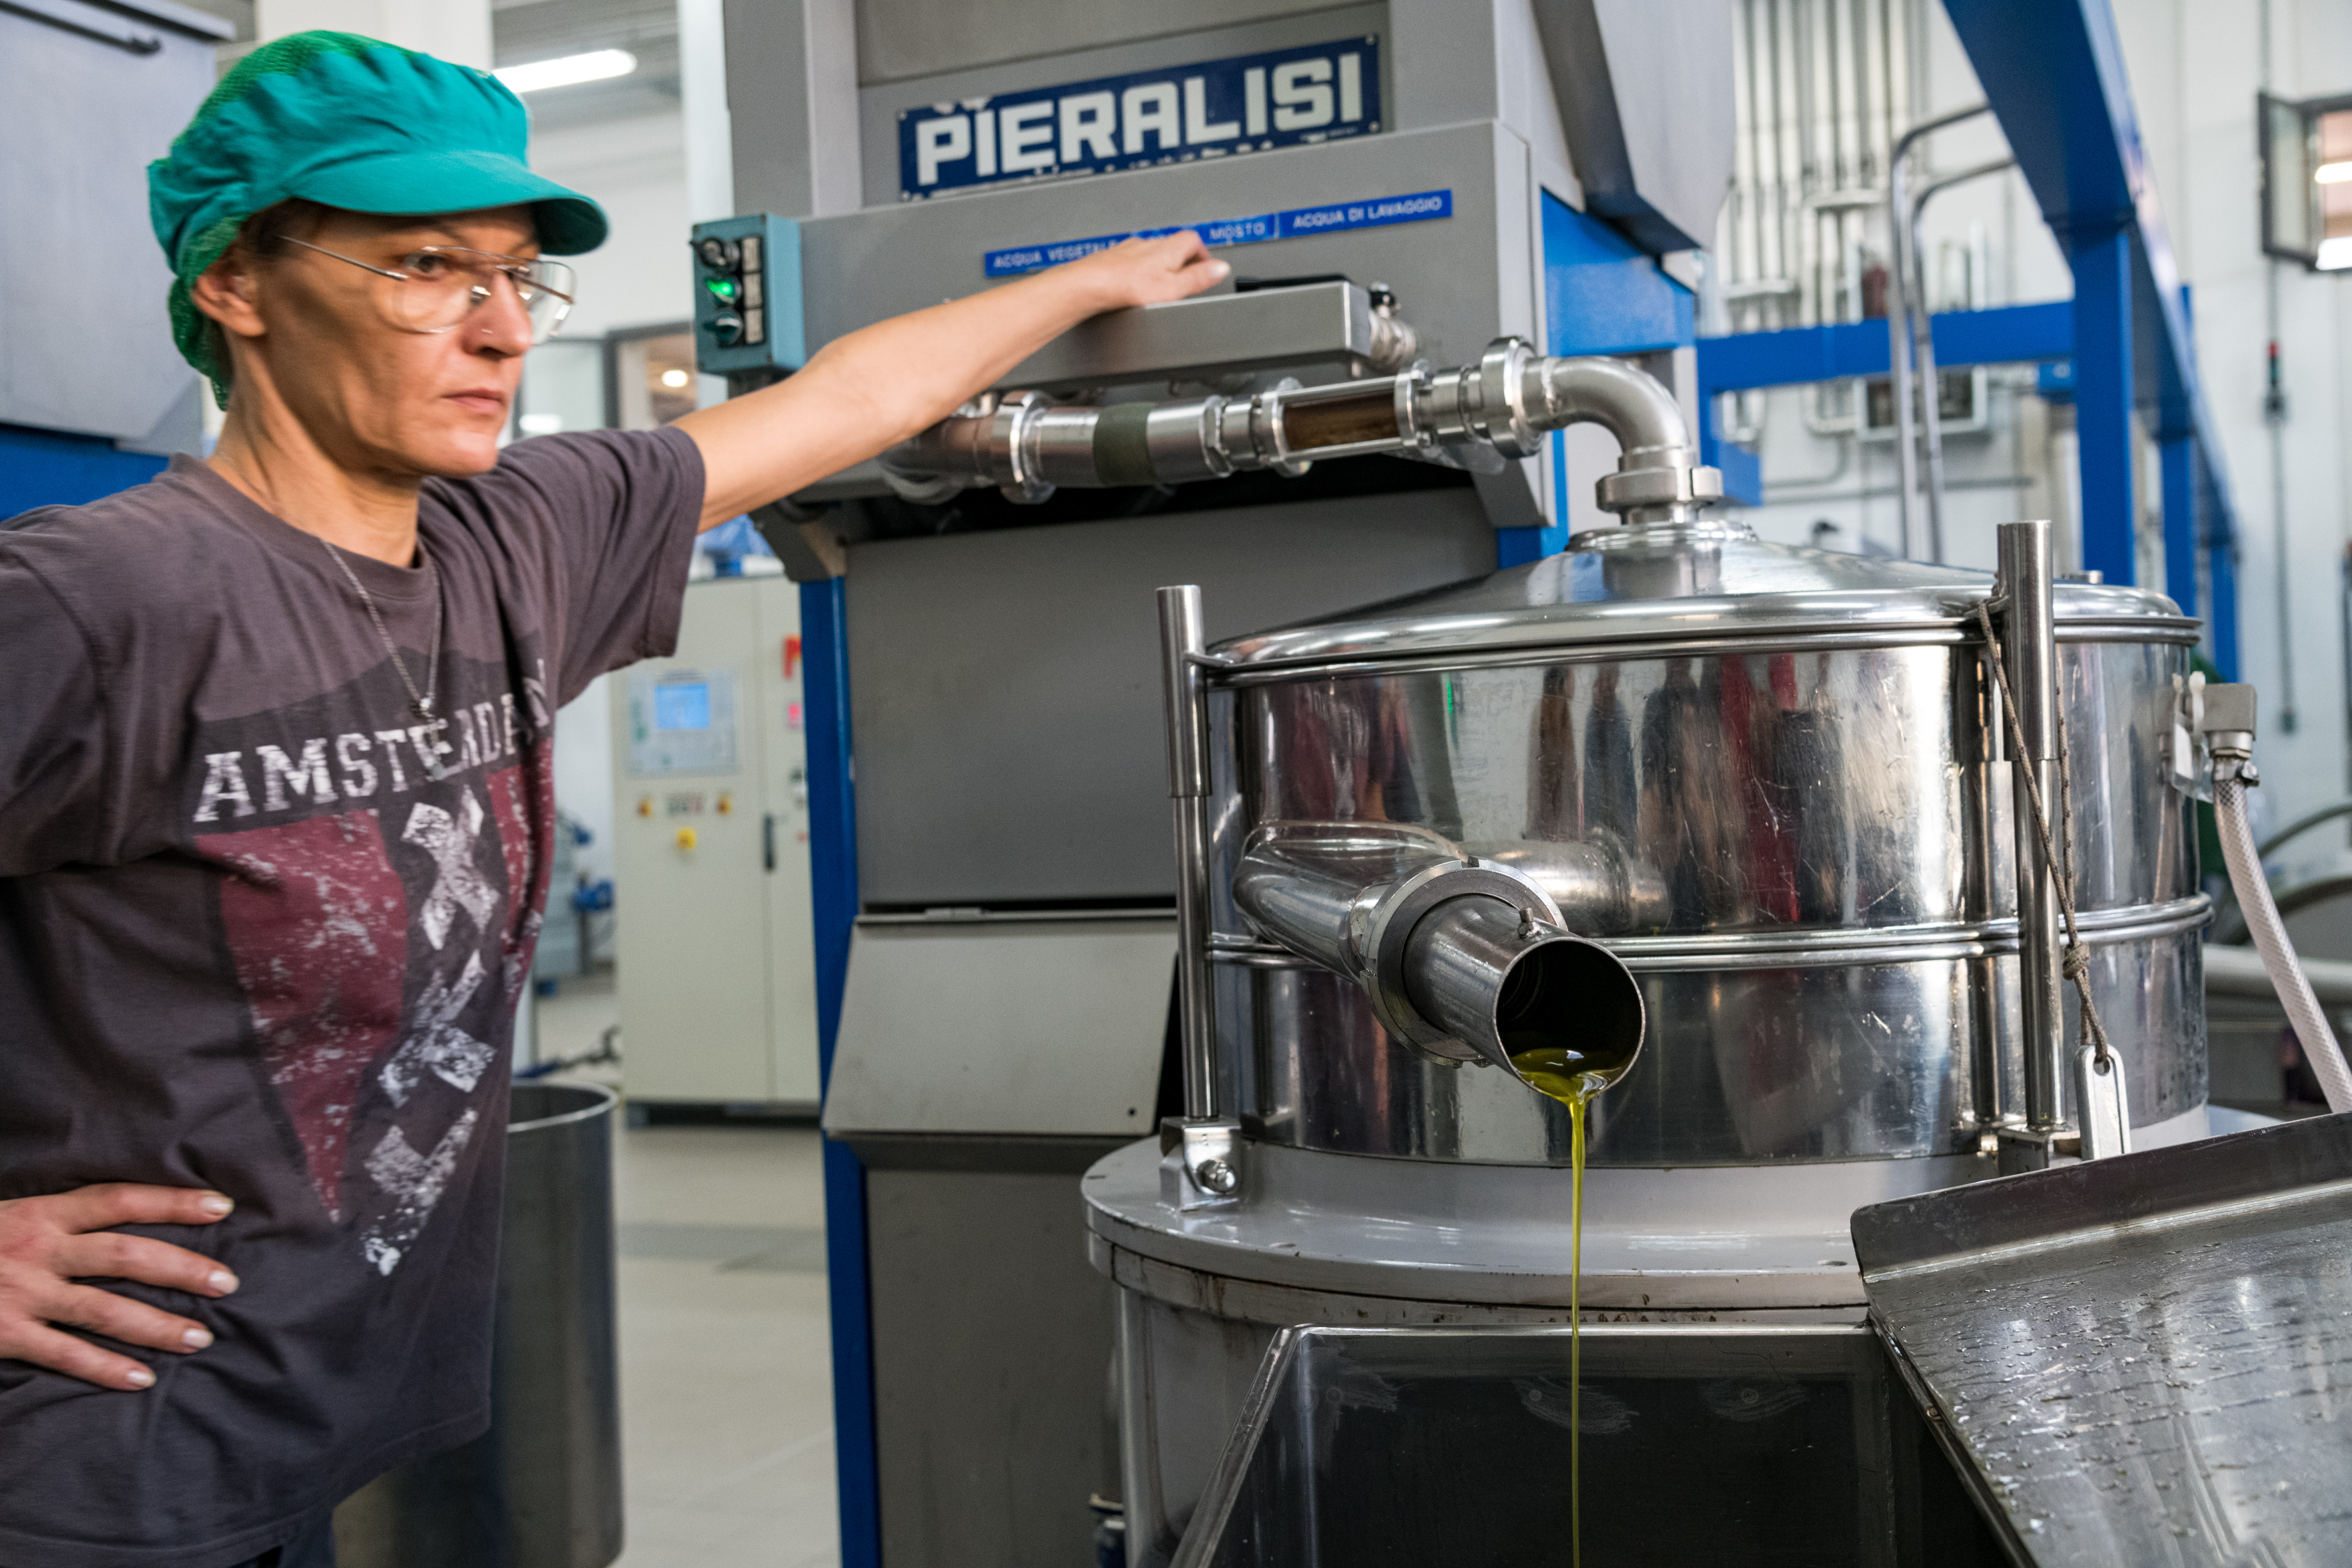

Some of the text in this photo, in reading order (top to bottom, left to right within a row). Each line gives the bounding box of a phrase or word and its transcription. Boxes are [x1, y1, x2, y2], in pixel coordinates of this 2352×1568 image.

[916, 53, 1363, 186] PIERALISI
[1293, 196, 1442, 228] ACQUA DI LAVAGGIO
[1209, 222, 1266, 240] MOSTO
[993, 250, 1043, 267] ACQUA
